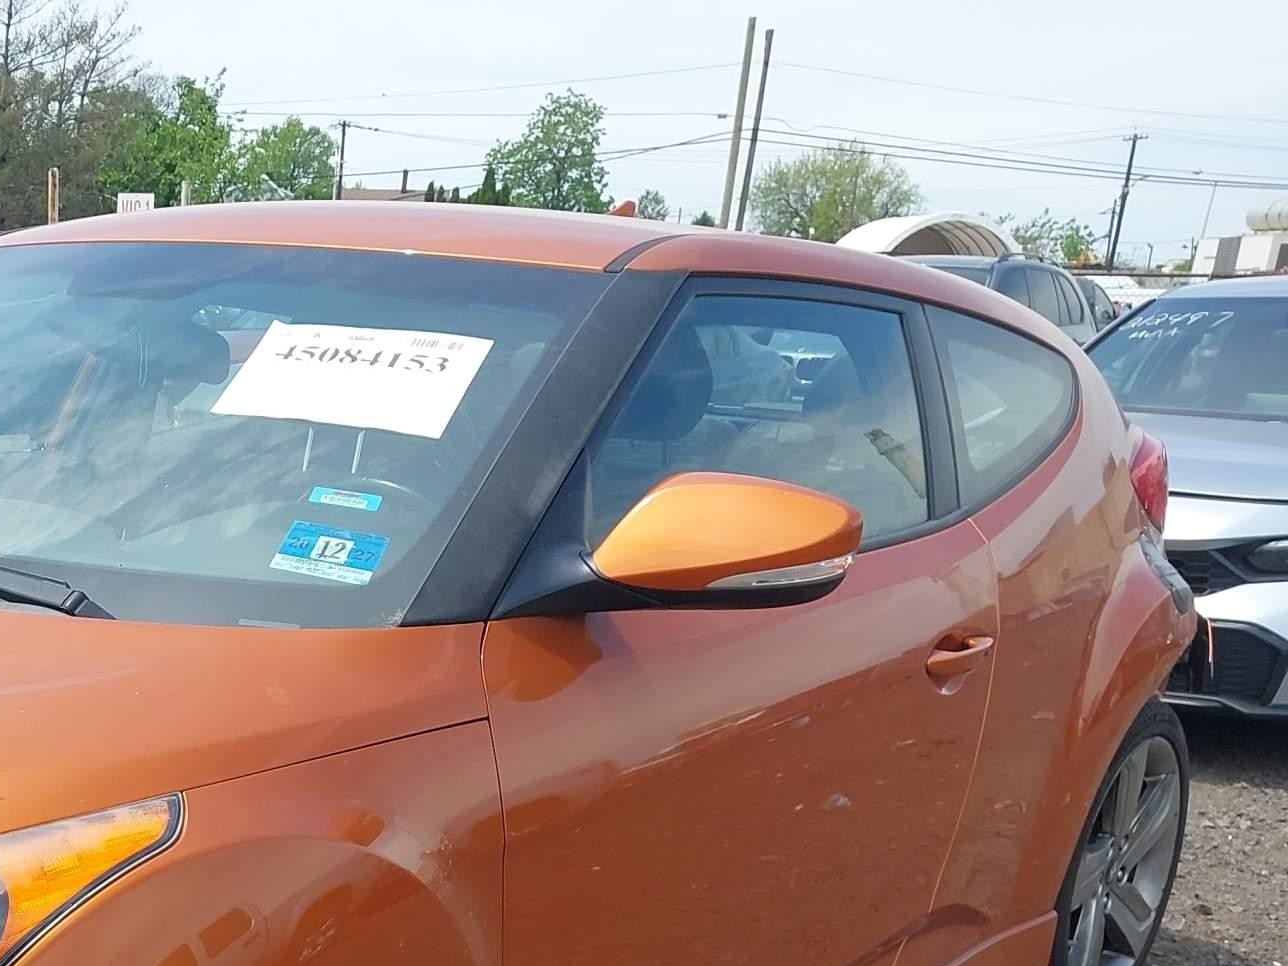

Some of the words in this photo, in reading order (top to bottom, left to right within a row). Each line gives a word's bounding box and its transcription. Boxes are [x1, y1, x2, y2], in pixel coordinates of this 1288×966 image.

[274, 344, 450, 374] 45084153
[316, 539, 348, 560] 12
[351, 549, 376, 563] 27
